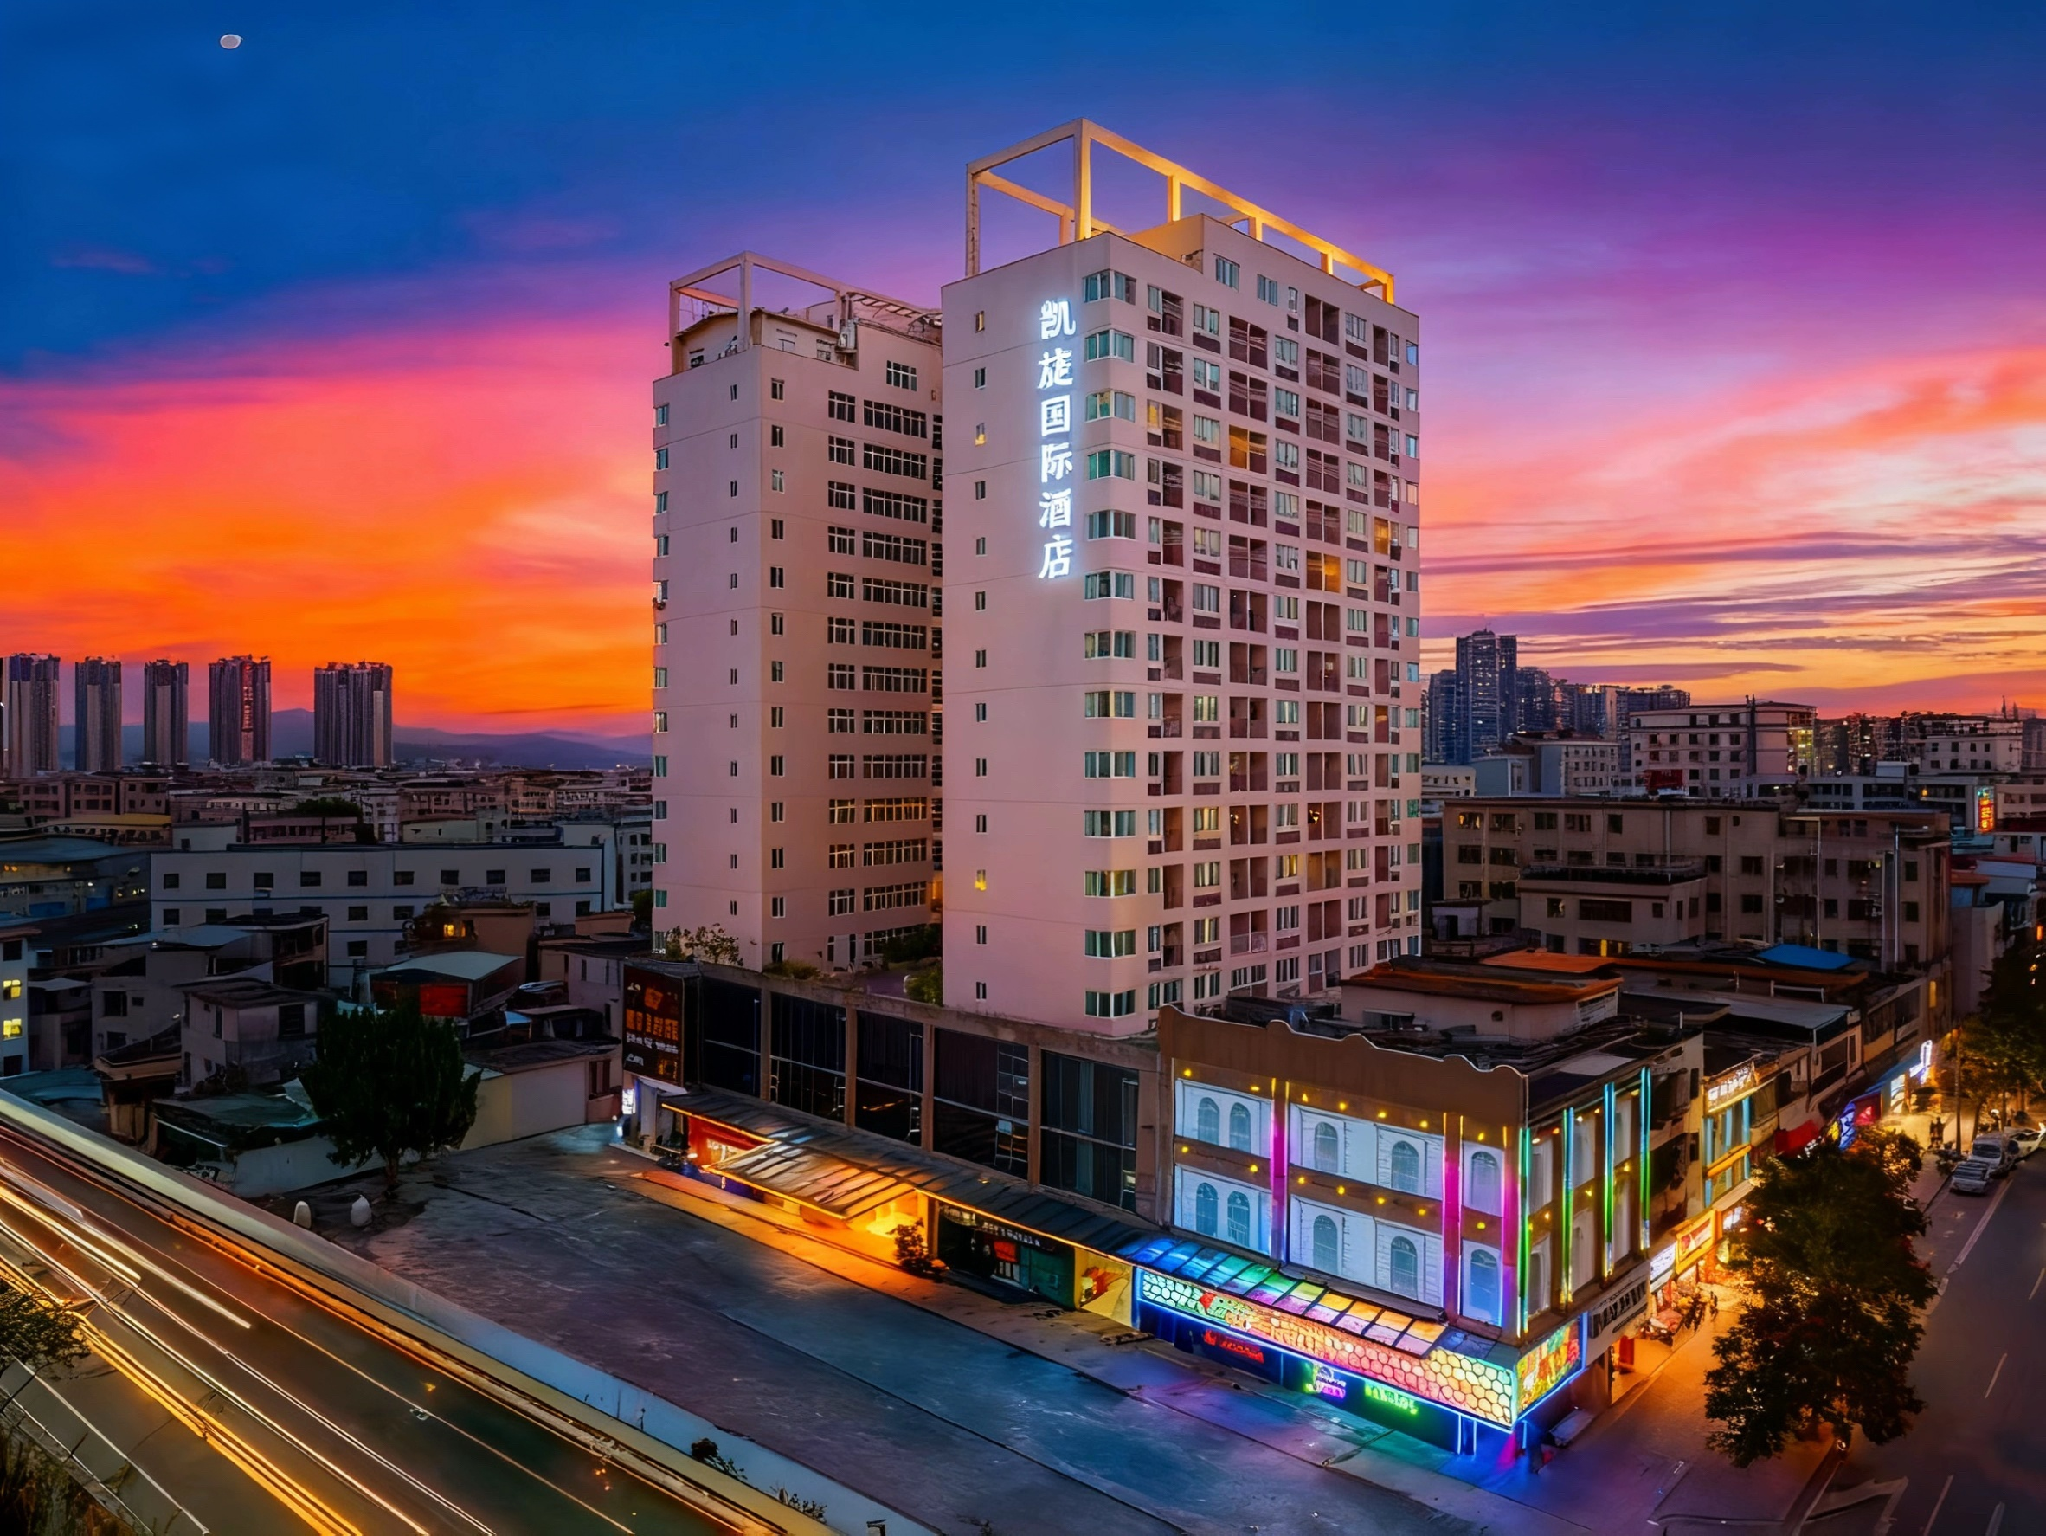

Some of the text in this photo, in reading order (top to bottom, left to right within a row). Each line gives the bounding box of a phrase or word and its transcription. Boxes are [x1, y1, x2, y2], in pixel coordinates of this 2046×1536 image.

[1038, 299, 1076, 579] 凯旋国际酒店
